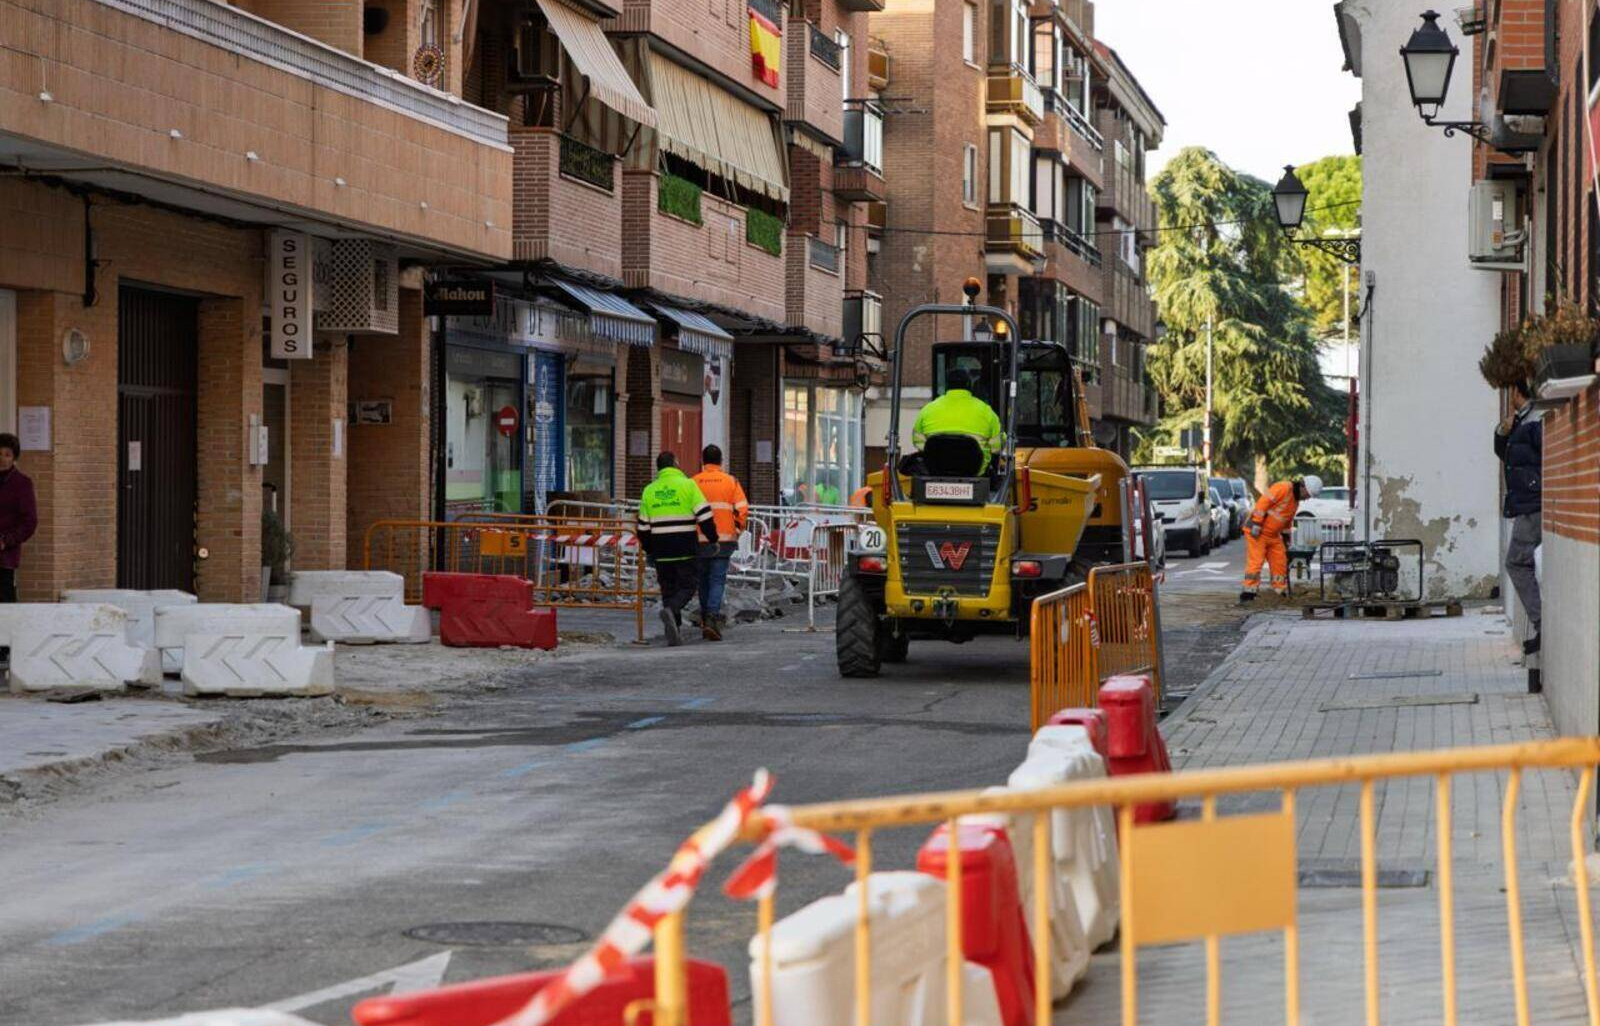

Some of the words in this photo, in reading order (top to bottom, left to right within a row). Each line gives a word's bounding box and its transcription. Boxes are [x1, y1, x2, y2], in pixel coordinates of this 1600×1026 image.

[282, 239, 298, 353] SEGUROS
[433, 287, 485, 300] Mahou
[866, 531, 881, 548] 20
